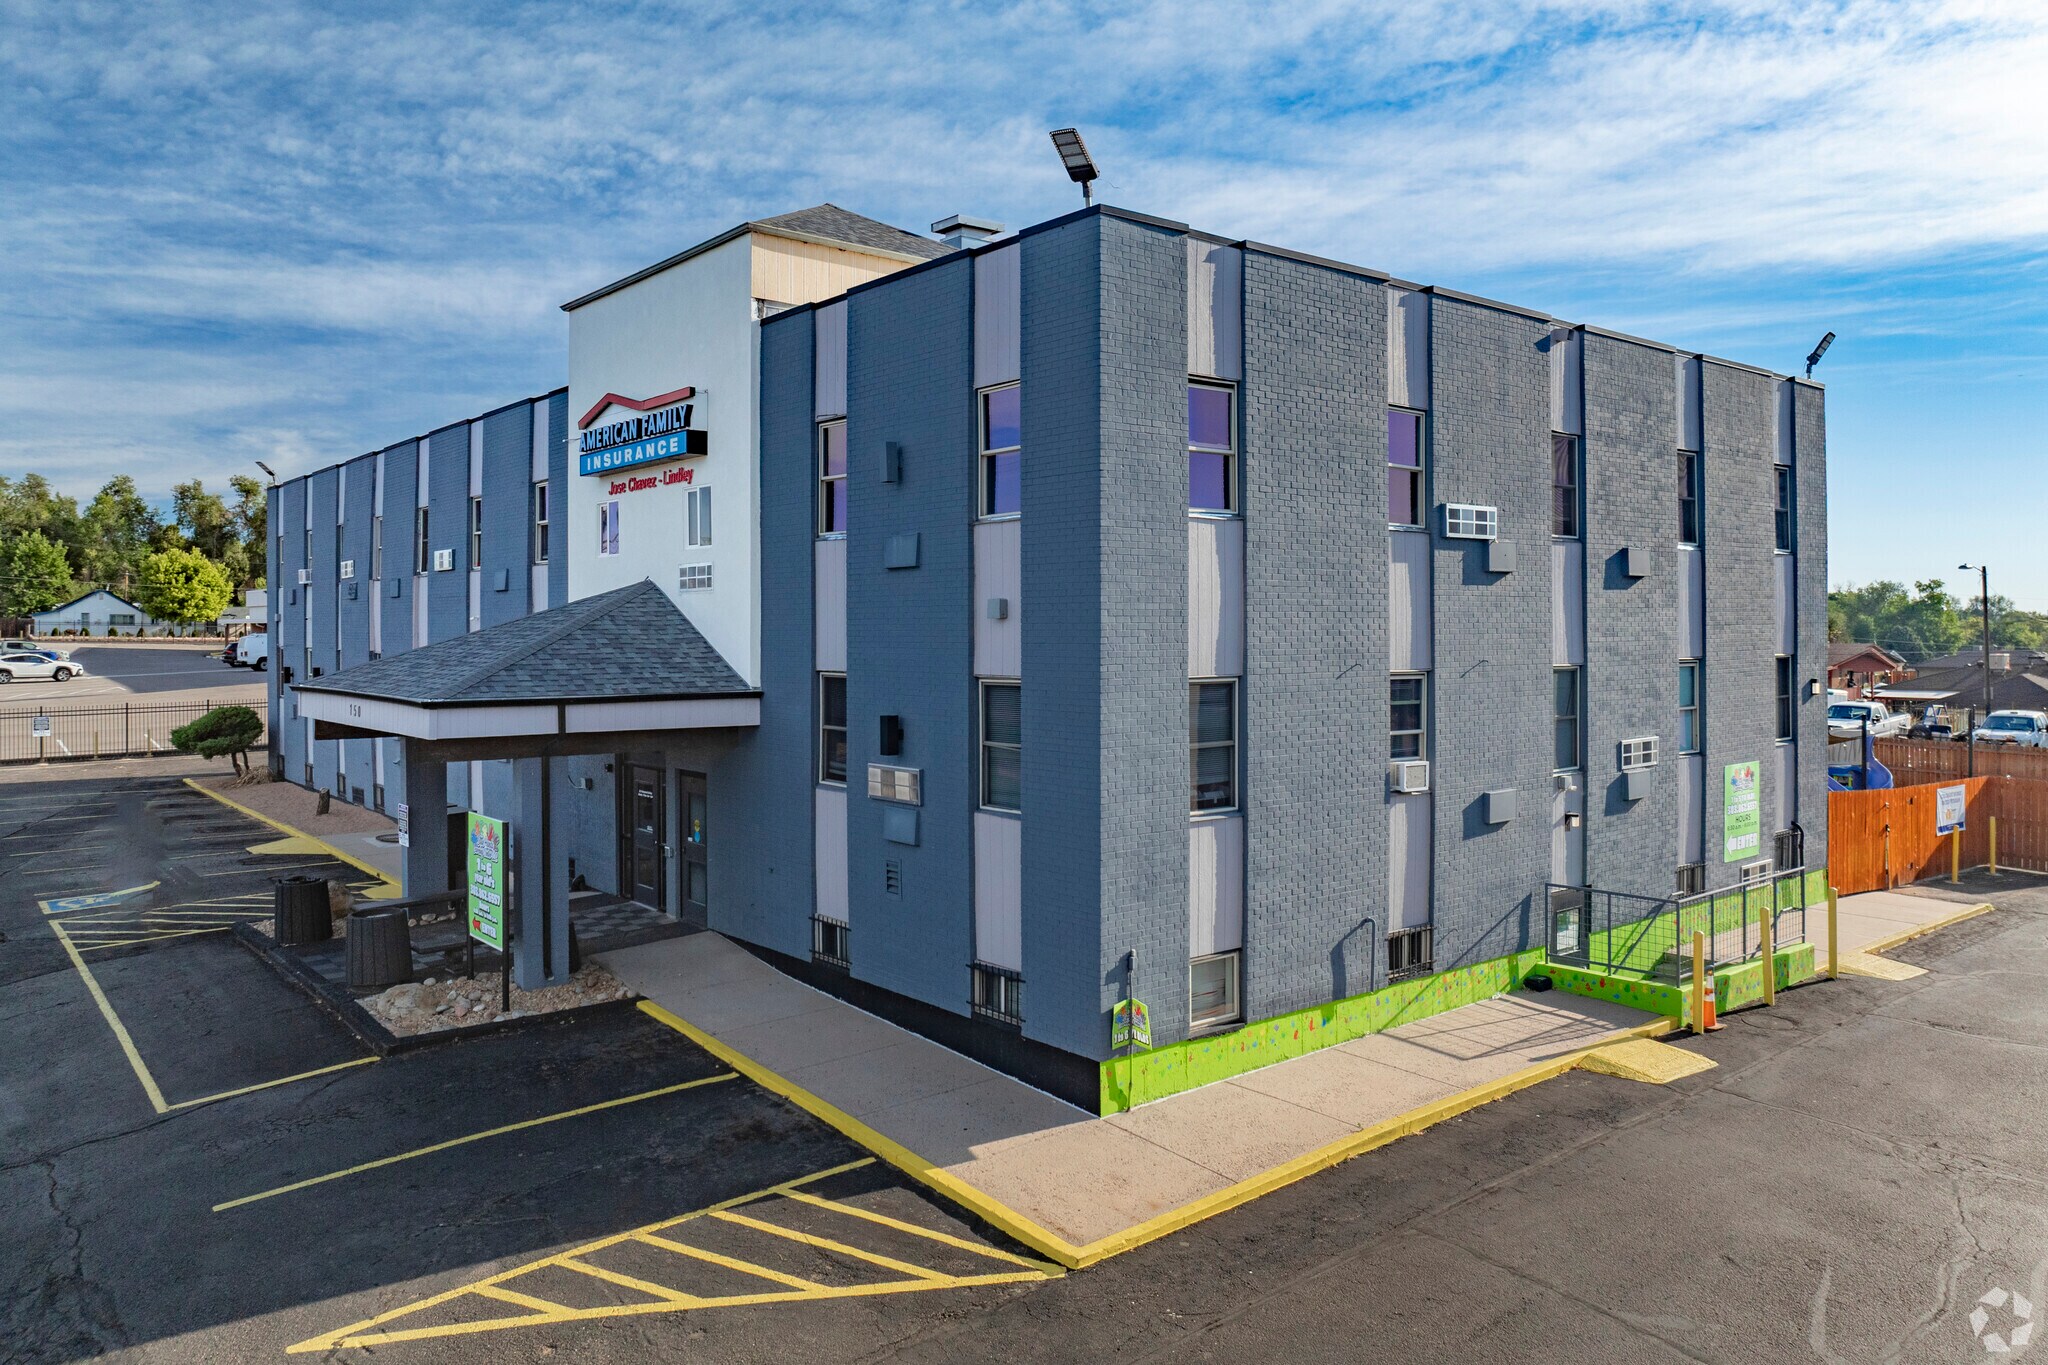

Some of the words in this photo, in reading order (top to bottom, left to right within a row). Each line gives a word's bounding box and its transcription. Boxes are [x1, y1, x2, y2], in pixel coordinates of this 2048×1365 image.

[579, 418, 639, 452] AMERICAN
[642, 404, 690, 436] FAMILY
[587, 437, 678, 471] INSURANCE
[609, 482, 626, 495] Jose
[628, 477, 657, 492] Chavez
[664, 467, 693, 485] Lindley
[350, 704, 361, 717] 150
